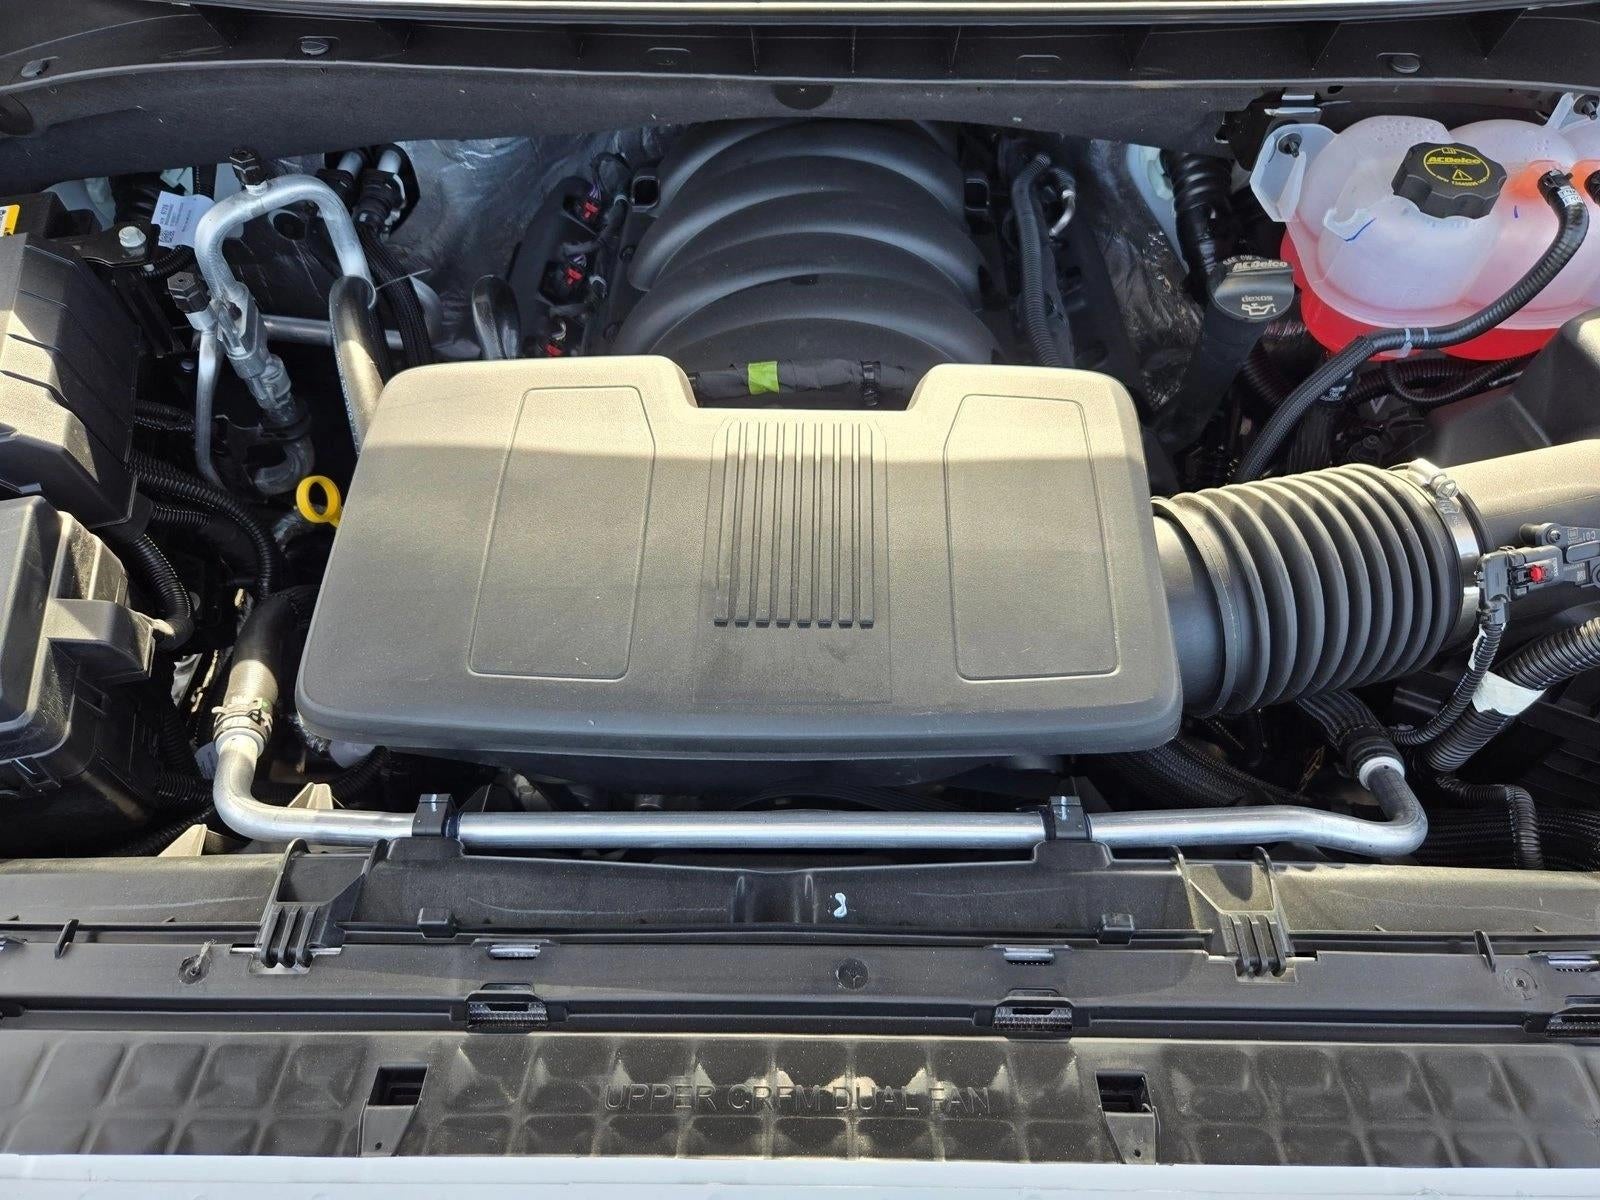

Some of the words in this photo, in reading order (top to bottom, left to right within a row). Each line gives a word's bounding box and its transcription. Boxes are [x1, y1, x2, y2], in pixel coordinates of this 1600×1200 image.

[1427, 157, 1481, 165] ACDelco
[1232, 260, 1288, 272] ACDelco
[605, 1083, 717, 1111] UPPER
[833, 1085, 920, 1112] DUAL
[931, 1086, 991, 1113] FAN
